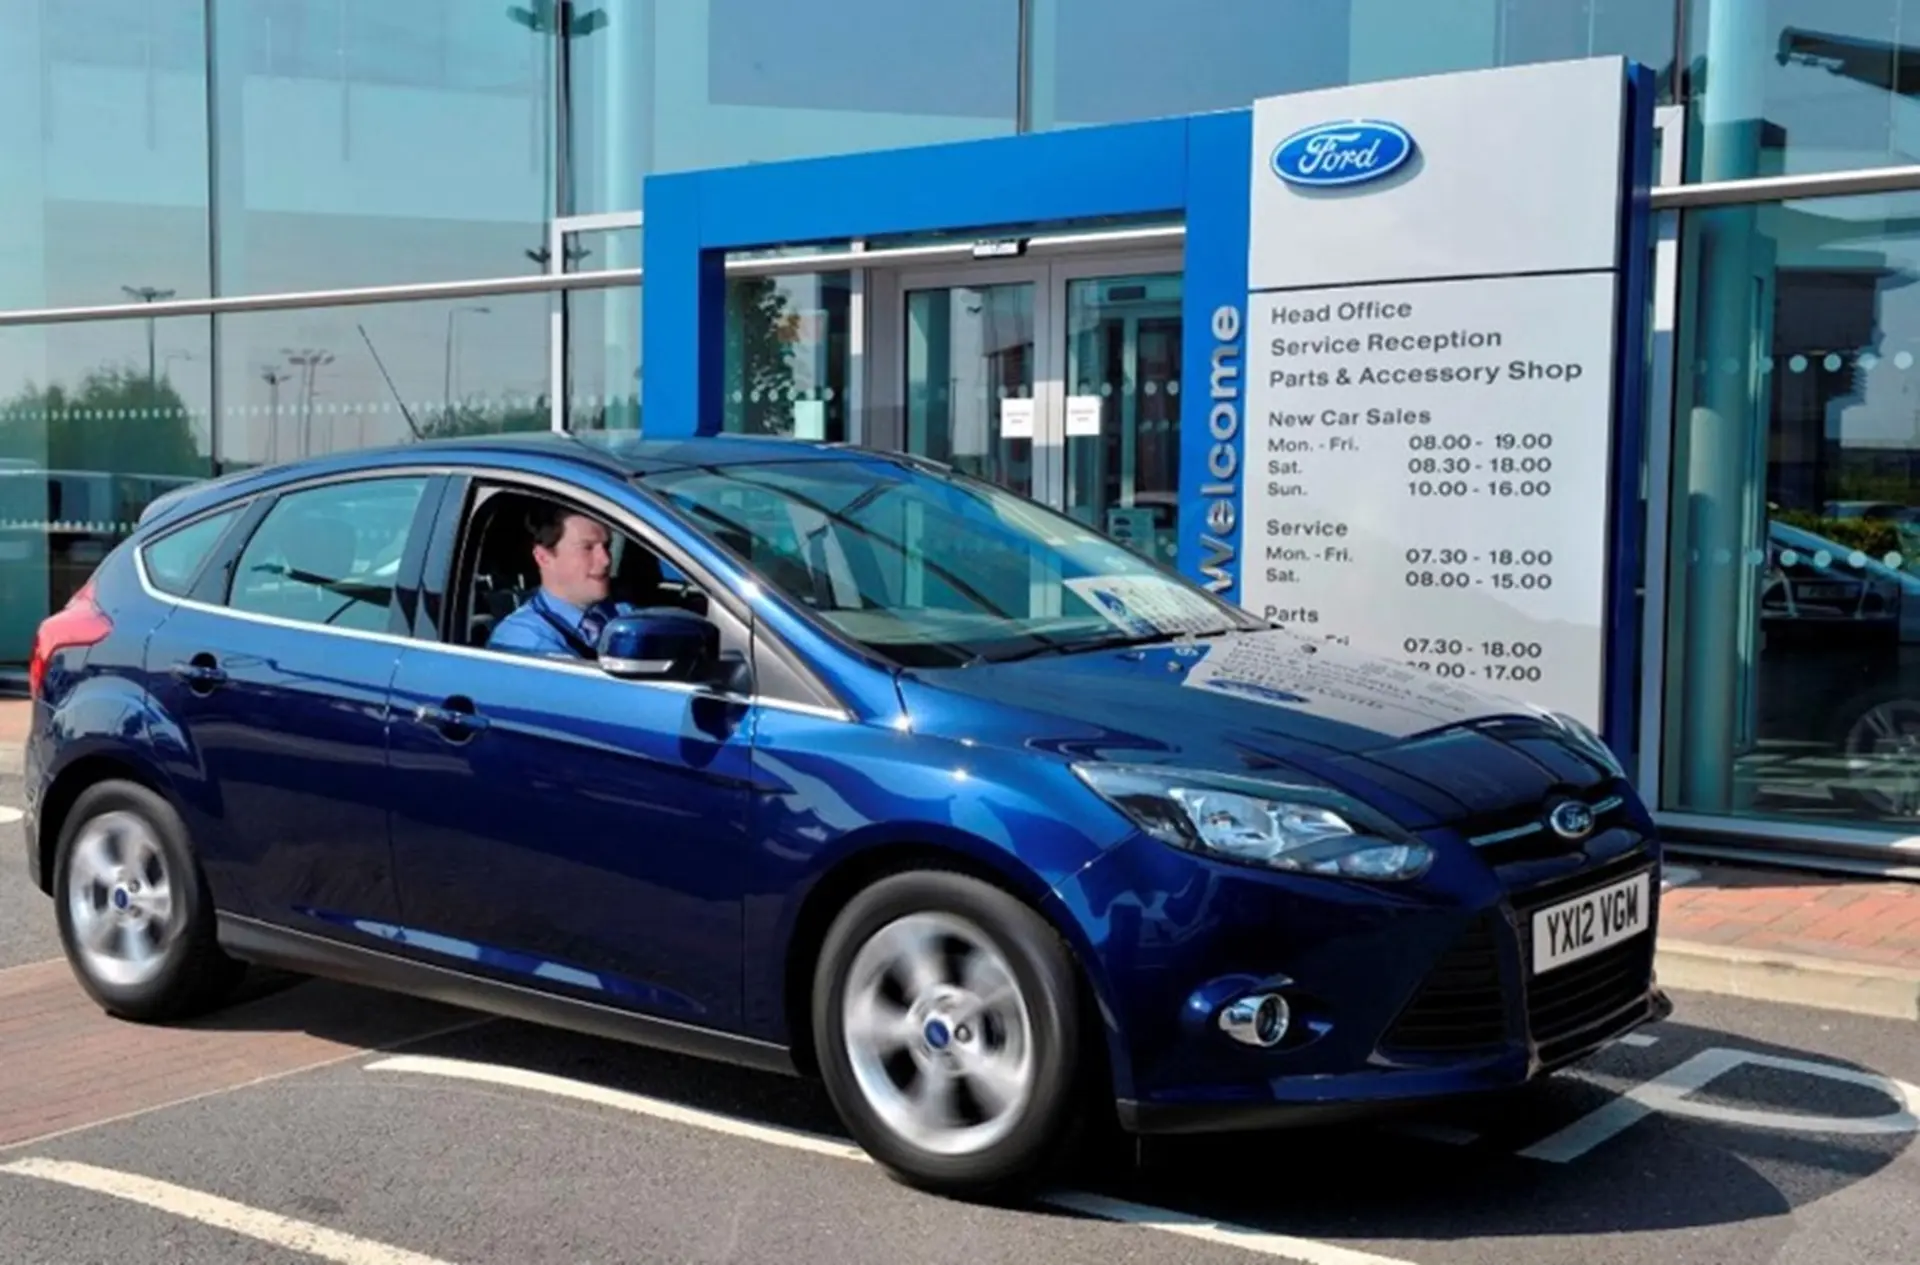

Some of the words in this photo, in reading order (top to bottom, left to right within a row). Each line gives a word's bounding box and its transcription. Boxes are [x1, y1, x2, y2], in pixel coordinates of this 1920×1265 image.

[1298, 131, 1380, 175] Ford
[1271, 304, 1331, 325] Head
[1337, 301, 1413, 321] Office
[1271, 335, 1361, 357] Service
[1367, 330, 1502, 353] Reception
[1269, 369, 1330, 388] Parts
[1335, 367, 1351, 386] &
[1358, 366, 1501, 385] Accessory
[1508, 360, 1583, 383] Shop
[1268, 411, 1315, 427] New
[1320, 409, 1360, 427] Car
[1366, 407, 1432, 426] Sales
[1200, 305, 1240, 593] Welcome
[1267, 437, 1314, 453] Mon.
[1329, 436, 1359, 451] Fri.
[1408, 433, 1472, 451] 08.00
[1495, 433, 1553, 450] 19.00
[1267, 459, 1303, 475] Sat.
[1407, 457, 1471, 474] 08.30
[1489, 456, 1552, 474] 18.00
[1267, 481, 1308, 497] Sun.
[1408, 480, 1468, 497] 10.00
[1488, 480, 1552, 497] 16.00
[1266, 519, 1348, 537] Service
[1266, 546, 1311, 561] Mon.
[1324, 546, 1353, 562] Fri.
[1405, 548, 1468, 565] 07.30
[1489, 549, 1553, 566] 18.00
[1265, 567, 1300, 583] Sat.
[1405, 570, 1470, 589] 08.00
[1491, 573, 1553, 590] 15.00
[1263, 605, 1319, 623] Parts
[1403, 637, 1463, 656] 07.30
[1481, 641, 1543, 659] 18.00
[1484, 664, 1542, 682] 17.00
[1547, 902, 1594, 956] YX12
[1601, 884, 1639, 937] VGM
